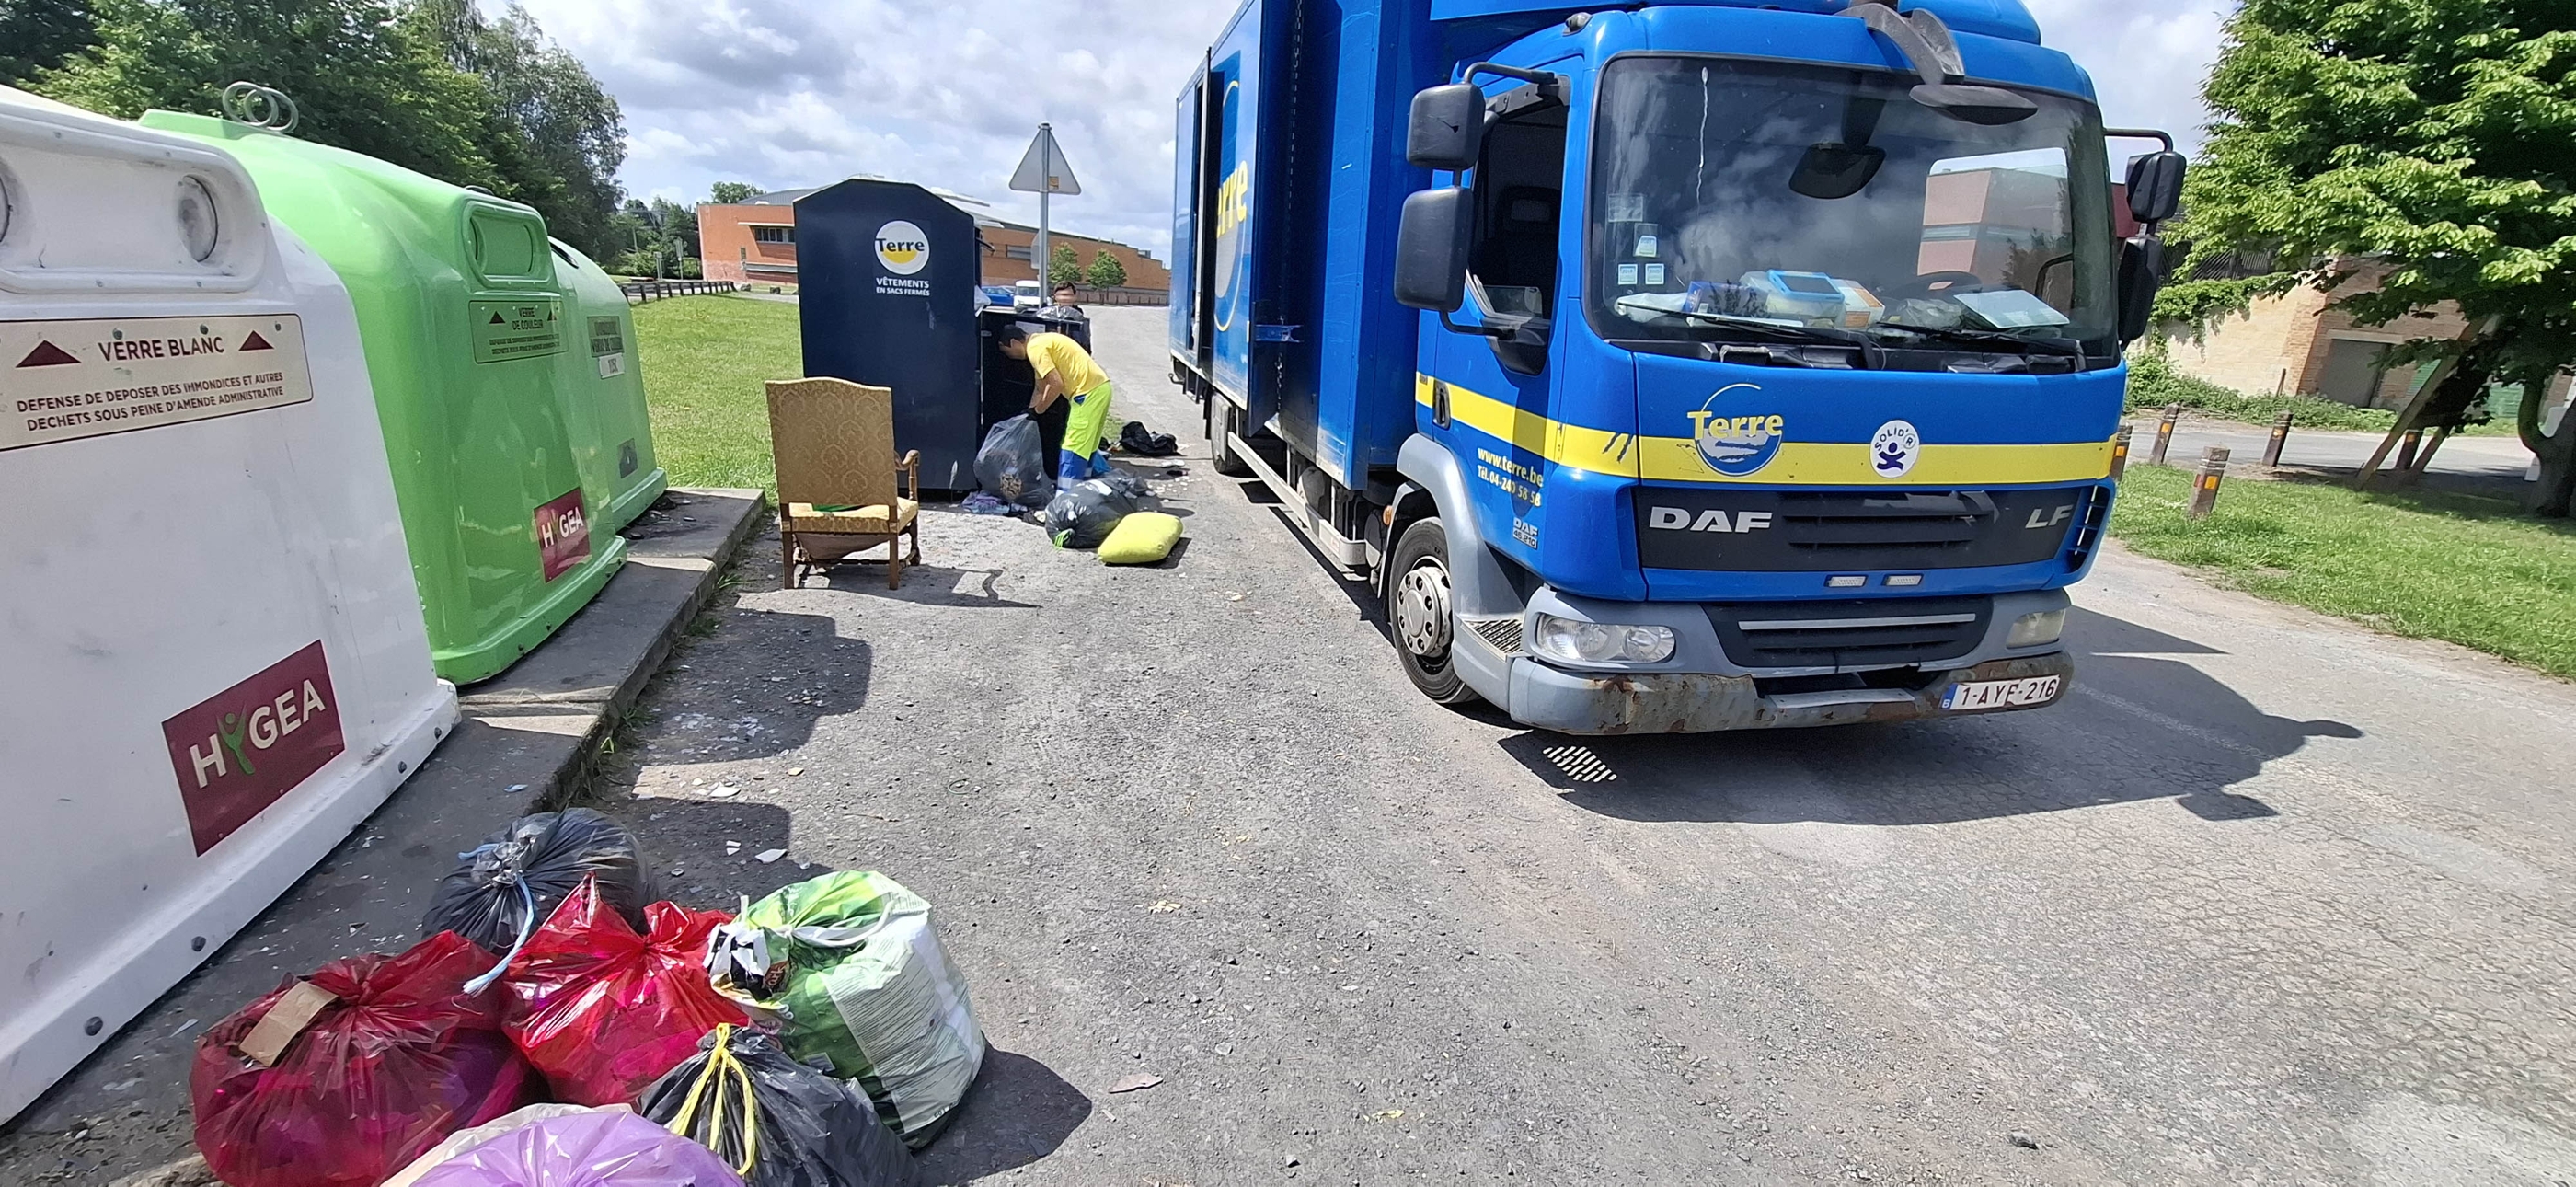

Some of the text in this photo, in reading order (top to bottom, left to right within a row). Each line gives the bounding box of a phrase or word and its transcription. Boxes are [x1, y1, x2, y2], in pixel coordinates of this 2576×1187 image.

[1217, 160, 1248, 238] rre
[875, 238, 925, 252] Terre
[876, 276, 929, 288] VÊTEMENTS
[98, 337, 224, 362] VERRE BLANC
[17, 372, 283, 412] DEFENSE DE DEPOSER DES IMMONDICES ET AUTRES
[27, 386, 284, 431] DECHETS SOUS PEINE D'AMENDE ADMINISTRATIVE
[1687, 410, 1783, 441] Terre
[1477, 447, 1544, 488] www.terre.be
[1489, 471, 1516, 494] 04-240
[1518, 486, 1528, 501] 58
[1530, 492, 1541, 507] 58
[1513, 516, 1538, 536] DAF
[1650, 504, 2074, 533] DAF LF
[1941, 698, 1950, 709] B
